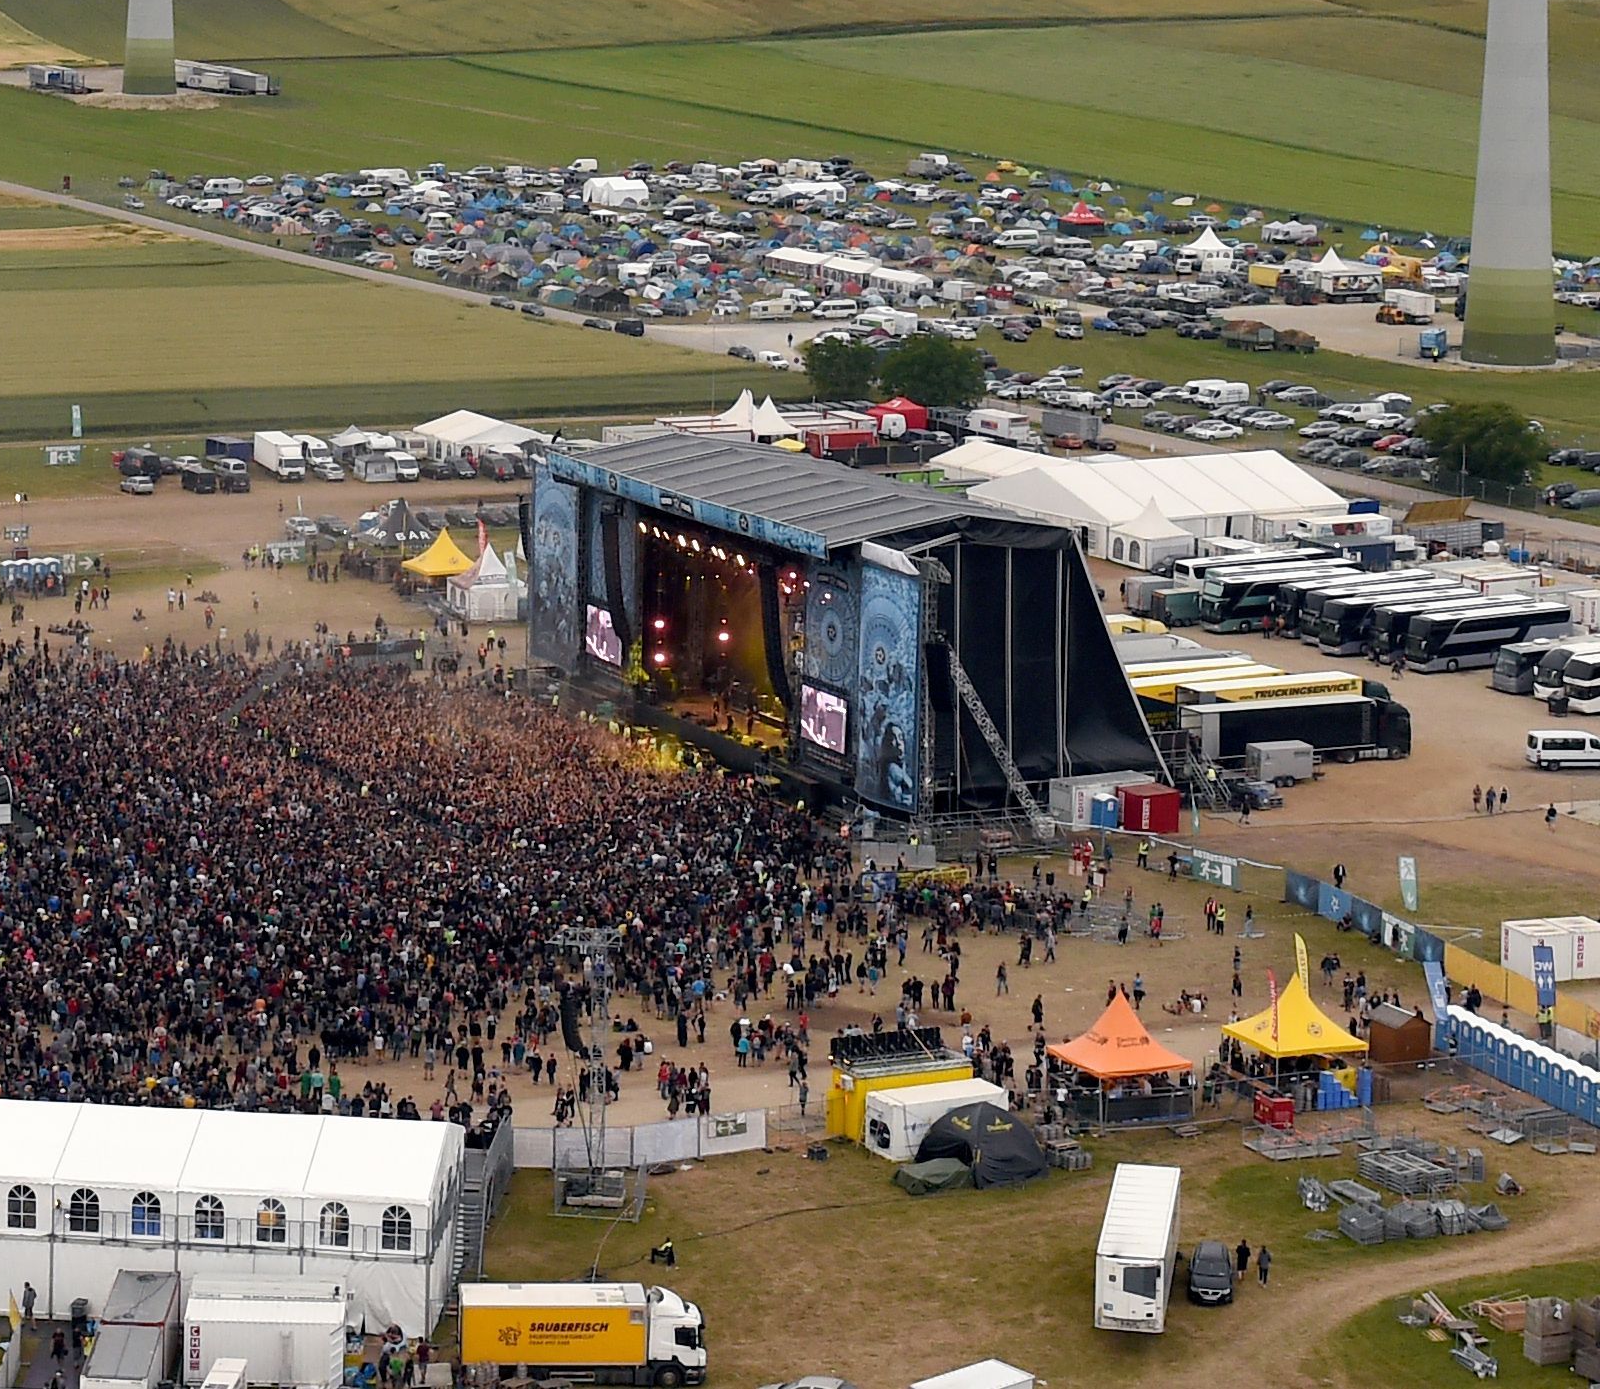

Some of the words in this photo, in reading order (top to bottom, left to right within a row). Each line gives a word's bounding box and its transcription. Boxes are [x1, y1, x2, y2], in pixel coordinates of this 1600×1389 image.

[395, 530, 431, 541] BAR
[1254, 683, 1350, 699] TRUCKINGSERVICE
[529, 1322, 609, 1332] SAUBERFISCH
